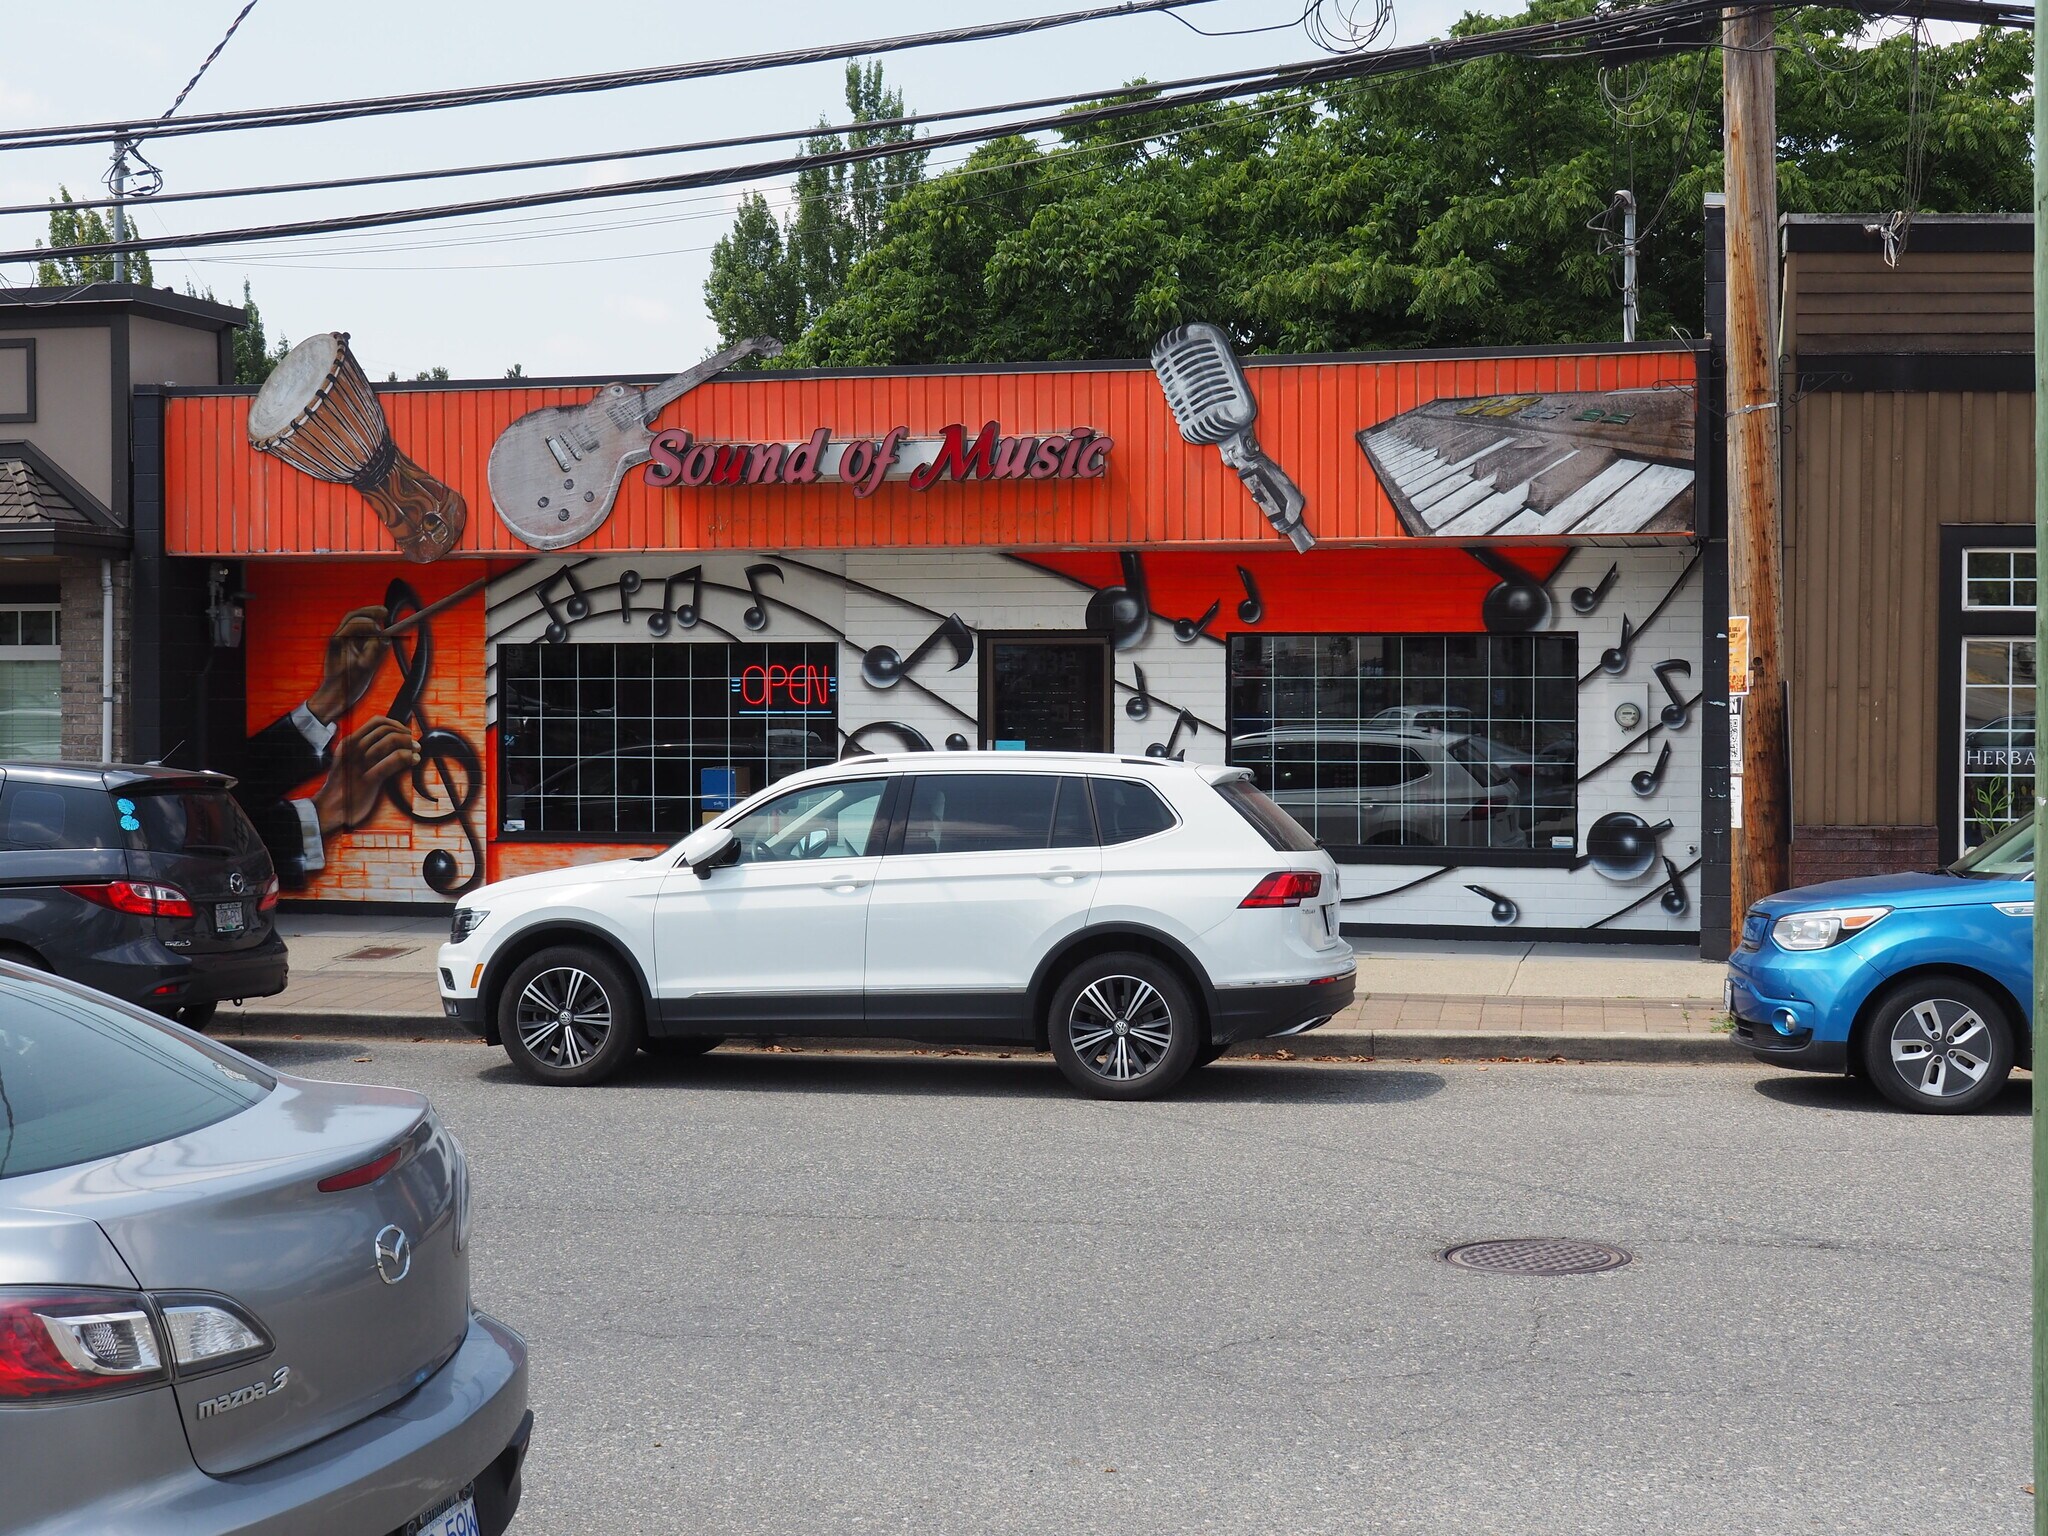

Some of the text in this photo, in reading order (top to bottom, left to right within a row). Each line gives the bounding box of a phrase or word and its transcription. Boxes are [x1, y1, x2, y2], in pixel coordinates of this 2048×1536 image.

[644, 420, 1115, 499] Sound of Music
[743, 665, 827, 705] OPEN
[1966, 750, 2035, 766] HERBA
